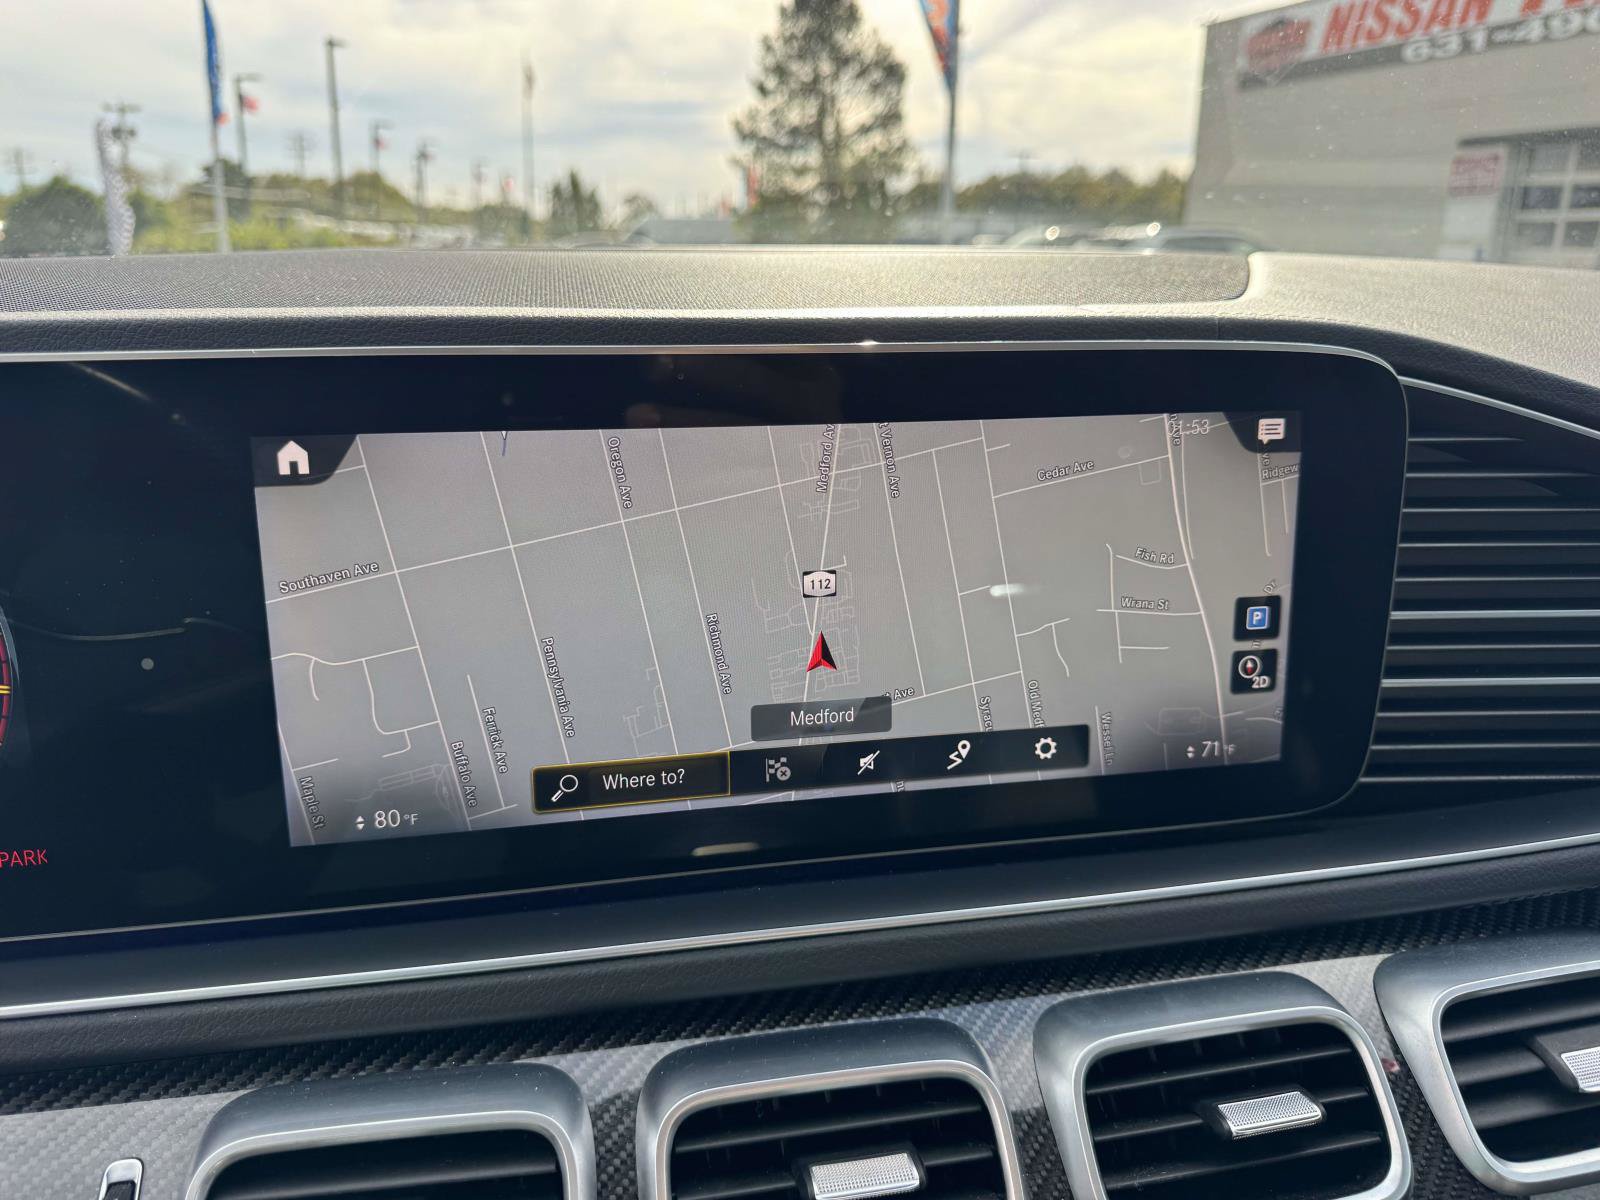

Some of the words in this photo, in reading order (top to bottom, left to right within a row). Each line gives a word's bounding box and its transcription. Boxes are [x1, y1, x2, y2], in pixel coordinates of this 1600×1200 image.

[1319, 0, 1492, 53] NISSAN
[880, 429, 897, 474] Vernon
[608, 437, 626, 483] Oregon
[619, 486, 632, 509] Ave
[816, 442, 833, 493] Medford
[1037, 464, 1070, 481] Cedar
[1073, 460, 1094, 473] Ave
[888, 476, 900, 498] Ave
[1135, 547, 1157, 563] Fish
[1159, 553, 1175, 564] Rd
[279, 567, 351, 594] Southaven
[354, 562, 379, 577] Ave
[810, 579, 831, 589] 112
[1121, 597, 1154, 608] Wrana
[1157, 600, 1169, 610] St
[706, 613, 729, 671] Richmond
[719, 673, 732, 694] Ave
[541, 637, 570, 713] Pennsylvania
[562, 715, 575, 737] Ave
[893, 687, 914, 700] Ave
[1028, 680, 1040, 700] Old
[1251, 676, 1269, 688] 2D
[790, 707, 854, 726] Medford
[483, 707, 504, 750] Ferrick
[494, 752, 508, 774] Ave
[1101, 712, 1113, 750] Wessel
[451, 741, 472, 783] Buffalo
[463, 785, 477, 808] Ave
[602, 772, 656, 790] Where
[661, 768, 685, 785] to?
[300, 776, 320, 813] Maple
[312, 815, 326, 831] St
[0, 849, 48, 868] PARK
